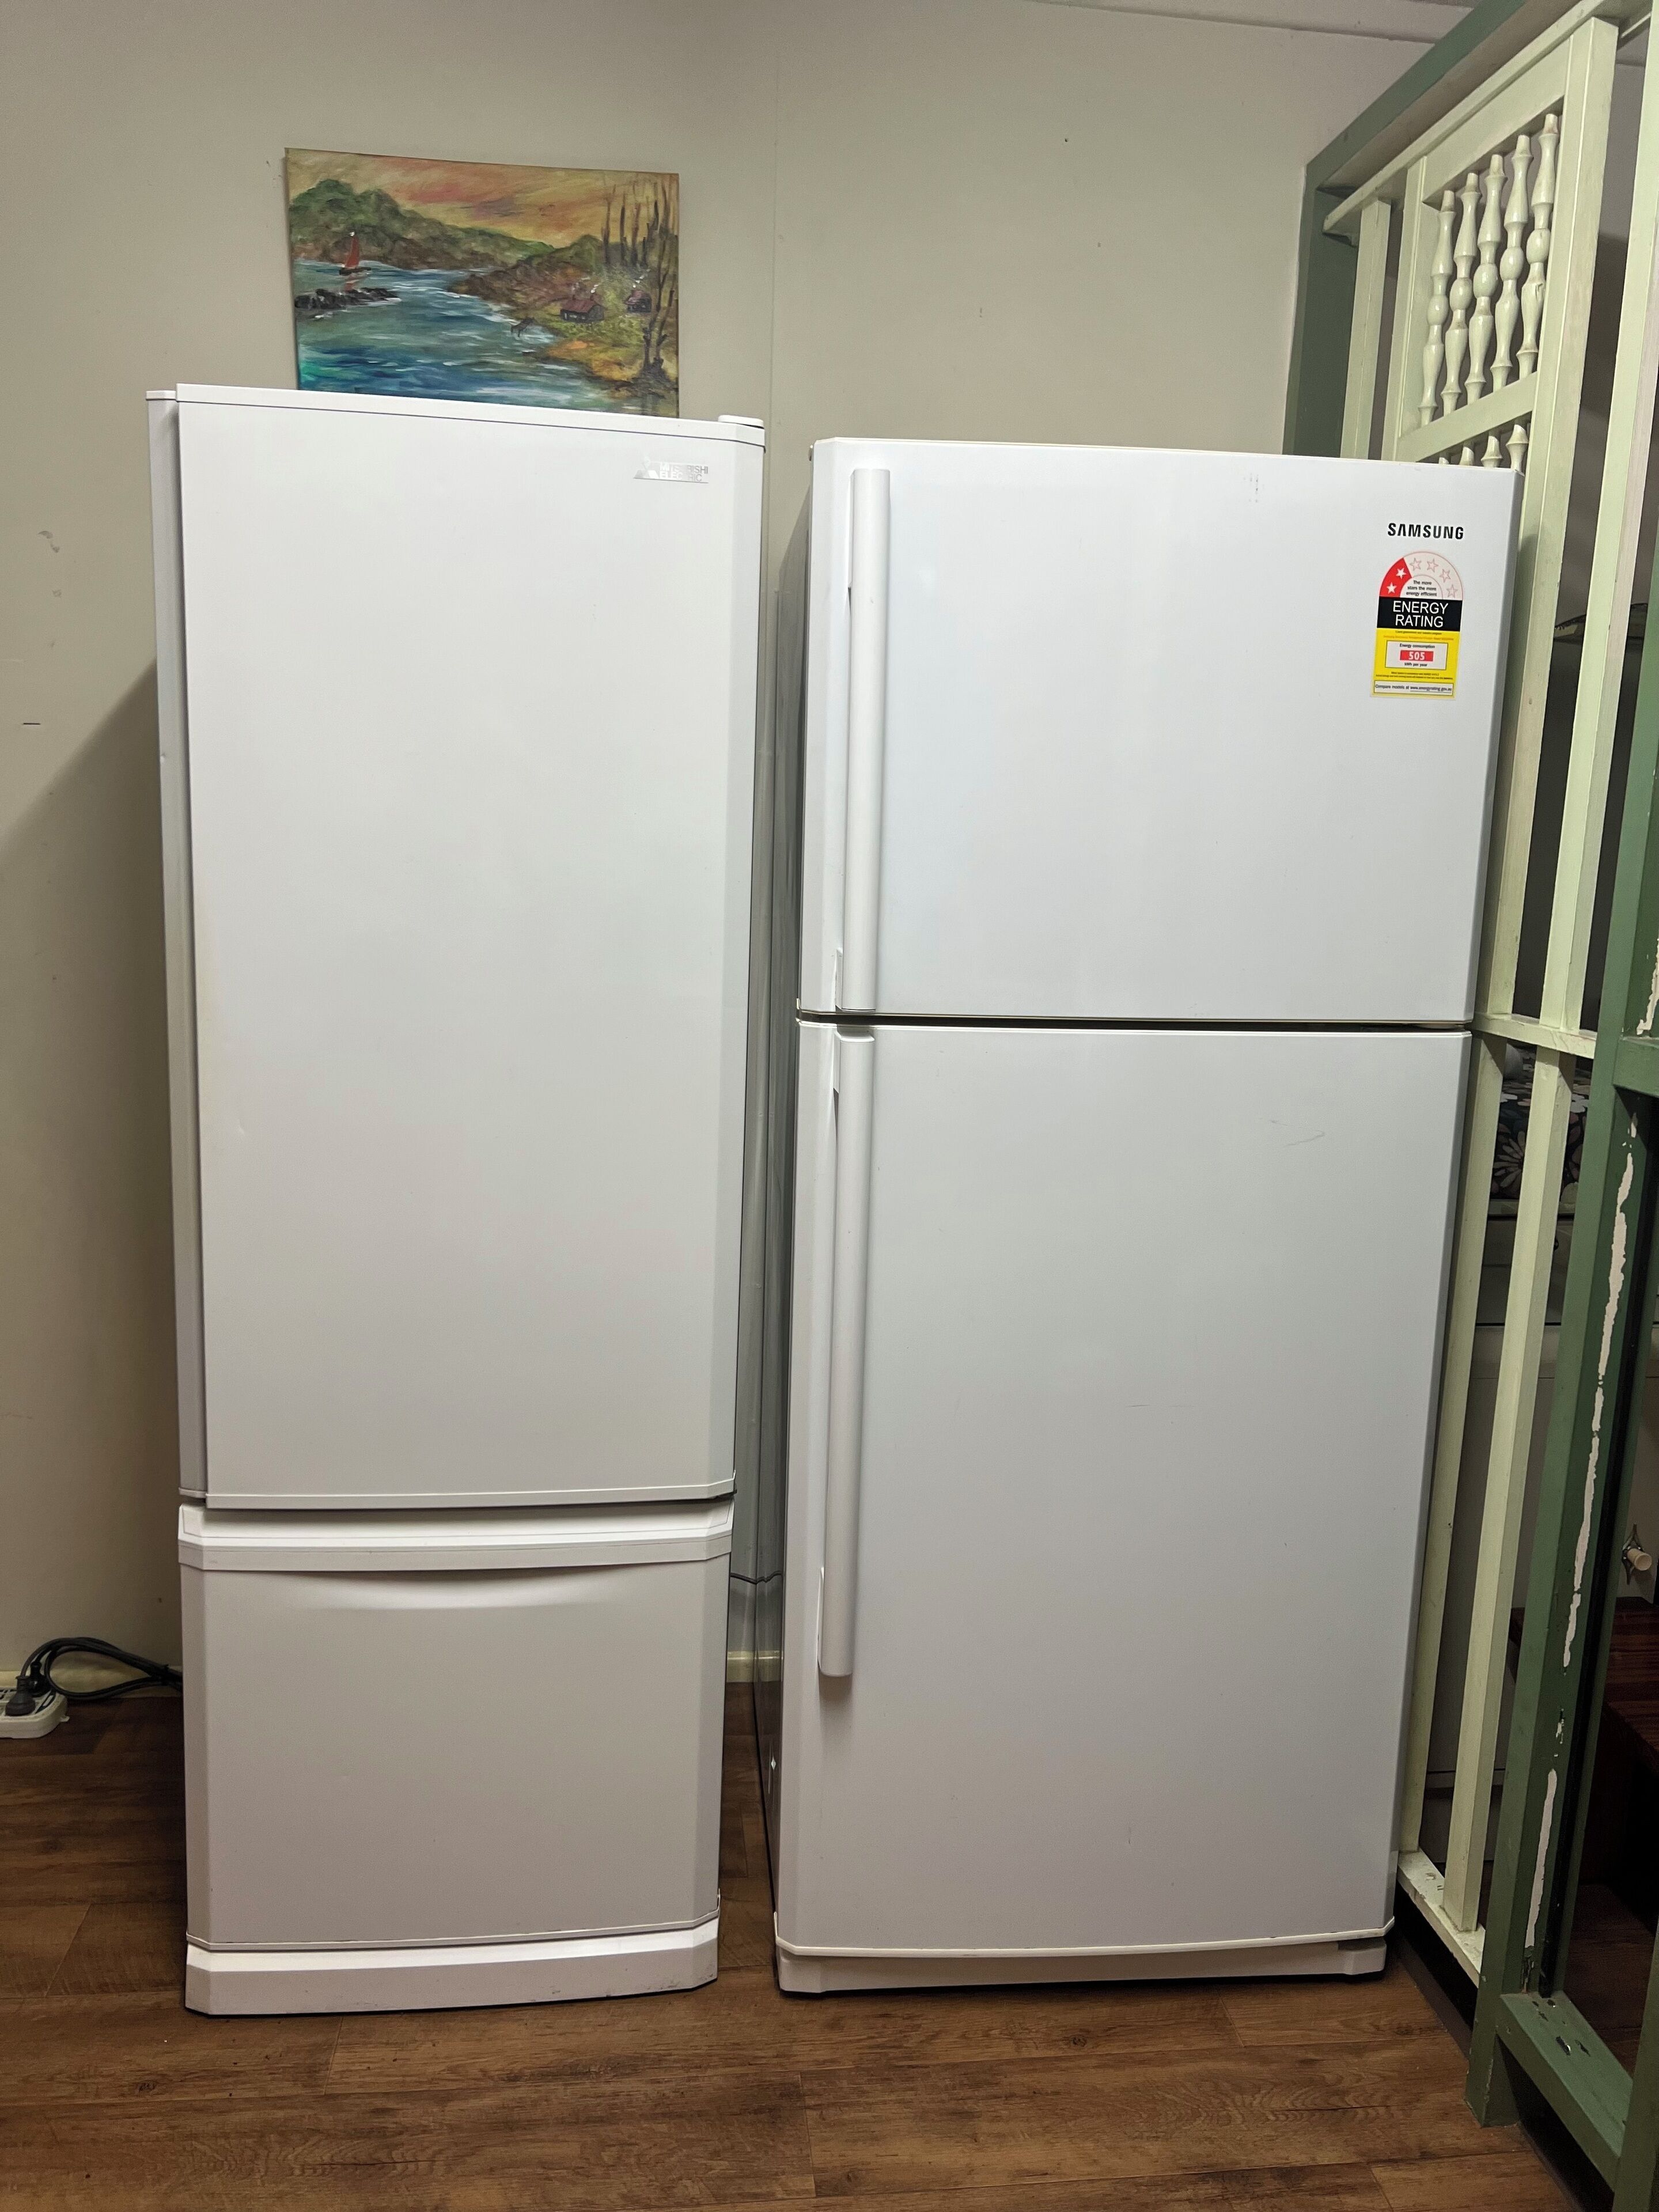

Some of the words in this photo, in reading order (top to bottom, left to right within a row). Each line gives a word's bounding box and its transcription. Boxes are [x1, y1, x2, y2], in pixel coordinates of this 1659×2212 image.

[660, 461, 709, 474] MITSBISHI
[659, 470, 702, 482] ELECRIC
[1387, 522, 1464, 540] SAMSUNG
[1393, 600, 1448, 614] ENERGY
[1395, 614, 1444, 628] RATING
[1408, 652, 1425, 661] 505
